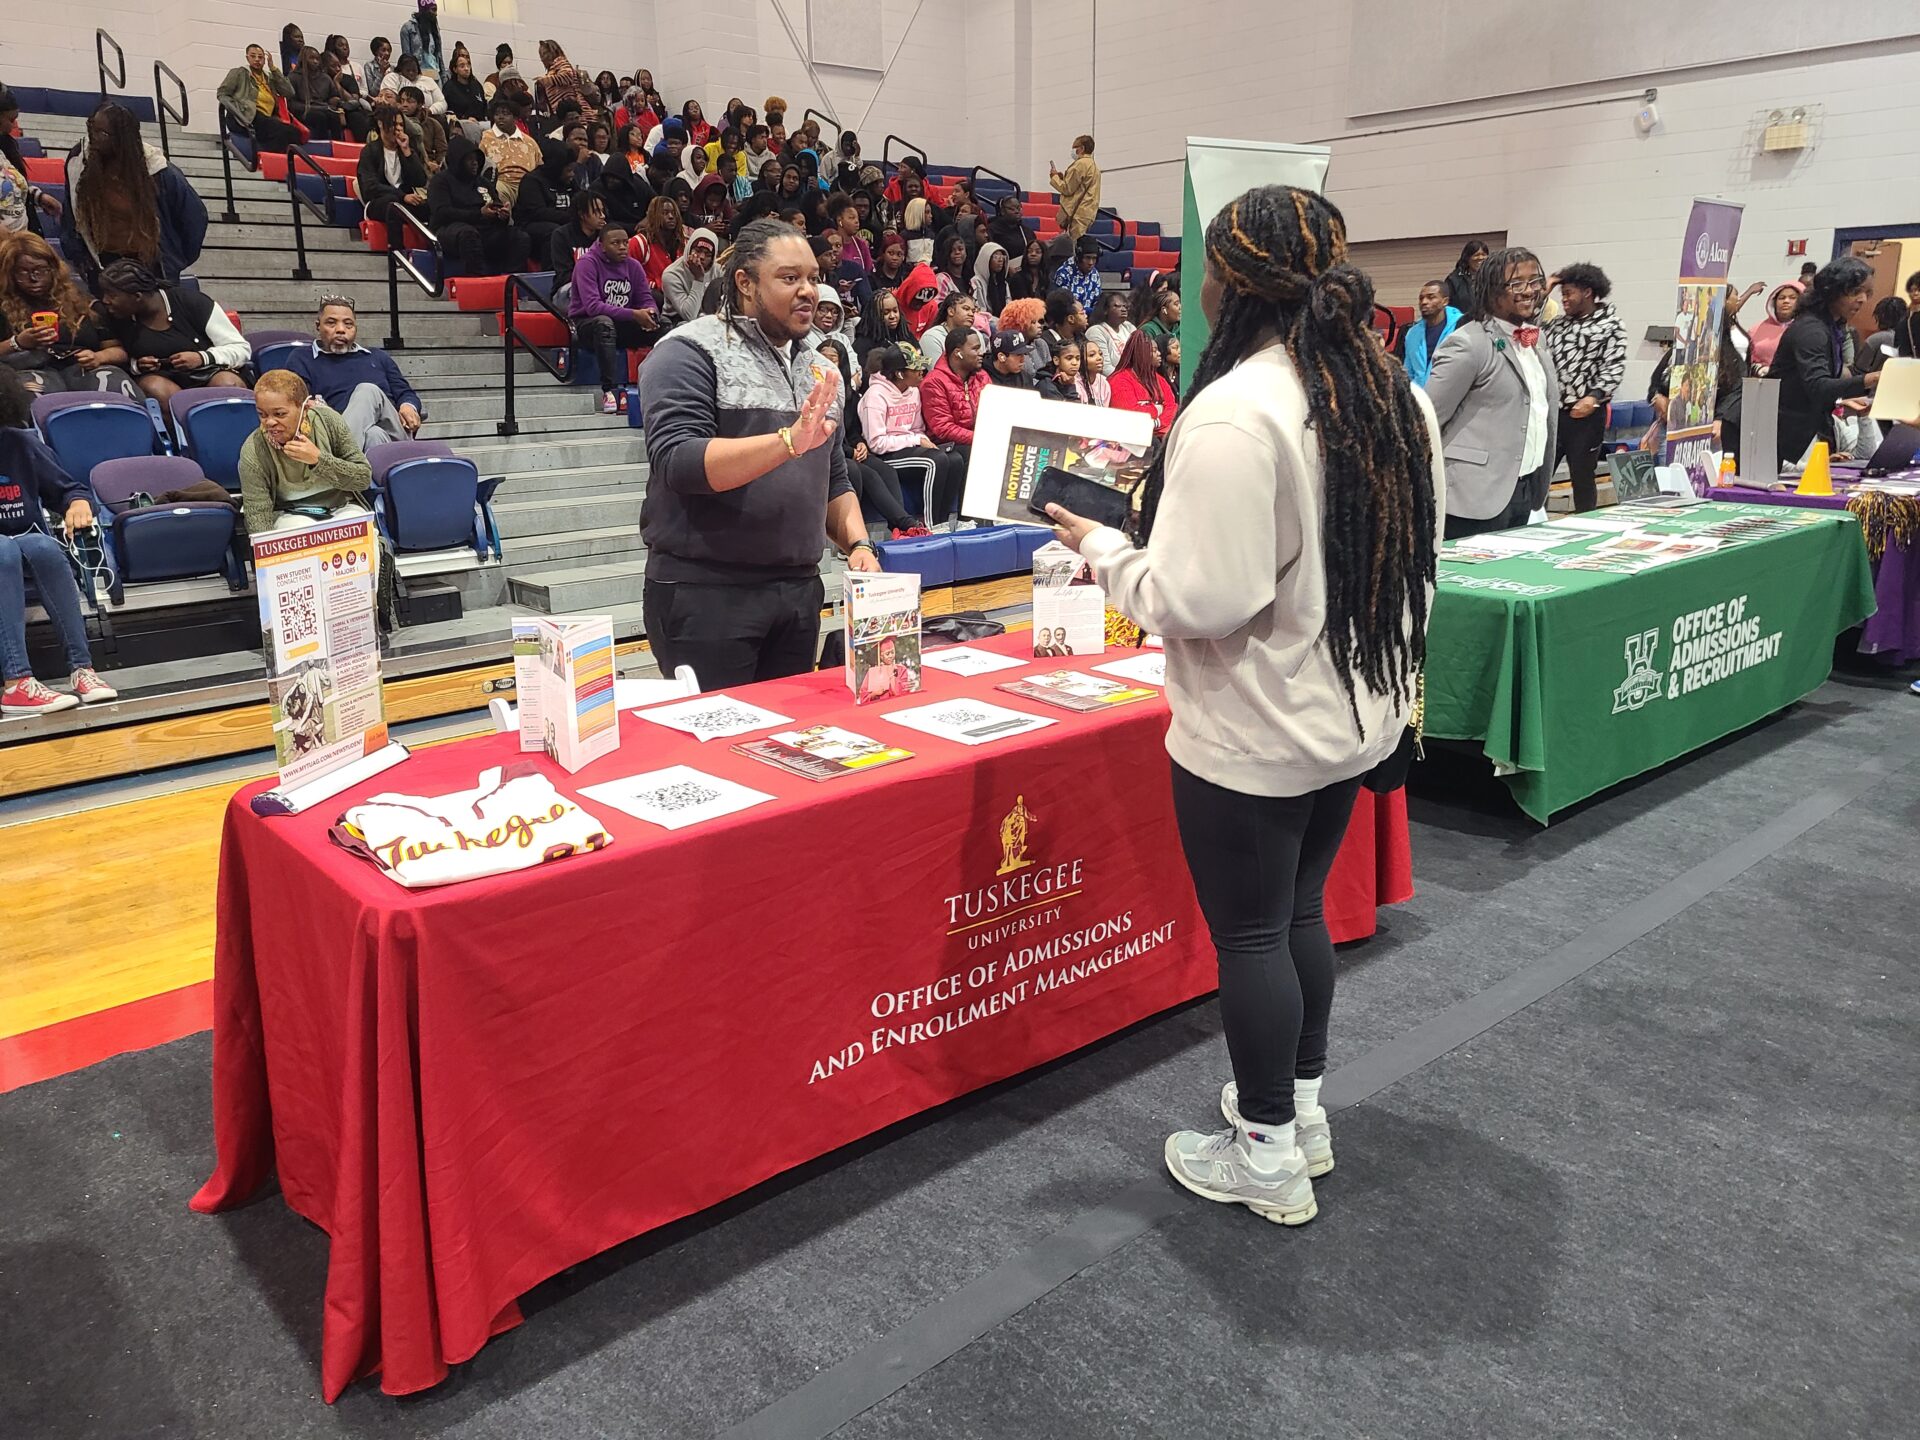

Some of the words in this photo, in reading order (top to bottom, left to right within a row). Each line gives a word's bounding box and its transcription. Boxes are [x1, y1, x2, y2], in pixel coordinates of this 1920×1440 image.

[604, 279, 632, 295] GRIND
[1006, 443, 1025, 501] MOTIVATE
[1019, 445, 1038, 500] EDUCATE
[257, 538, 308, 557] TUSKEGEE
[309, 524, 363, 545] UNIVERSITY
[276, 573, 289, 581] NEW
[289, 567, 311, 579] STUDENT
[276, 577, 299, 587] CONTACT
[335, 567, 356, 576] MAJORS
[1669, 615, 1761, 673] ADMISSIONS
[1672, 602, 1726, 644] OFFICE
[1727, 594, 1748, 625] OF
[1667, 671, 1680, 700] &
[1682, 631, 1783, 695] RECRUITMENT
[944, 858, 1084, 924] TUSKEGEE
[968, 905, 1062, 950] UNIVERSITY
[870, 973, 962, 1018] OFFICE
[968, 960, 998, 988] OF
[1002, 910, 1132, 977] ADMISSIONS
[808, 1041, 865, 1085] AND
[871, 980, 1030, 1055] ENROLLMENT
[1033, 920, 1176, 996] MANAGEMENT
